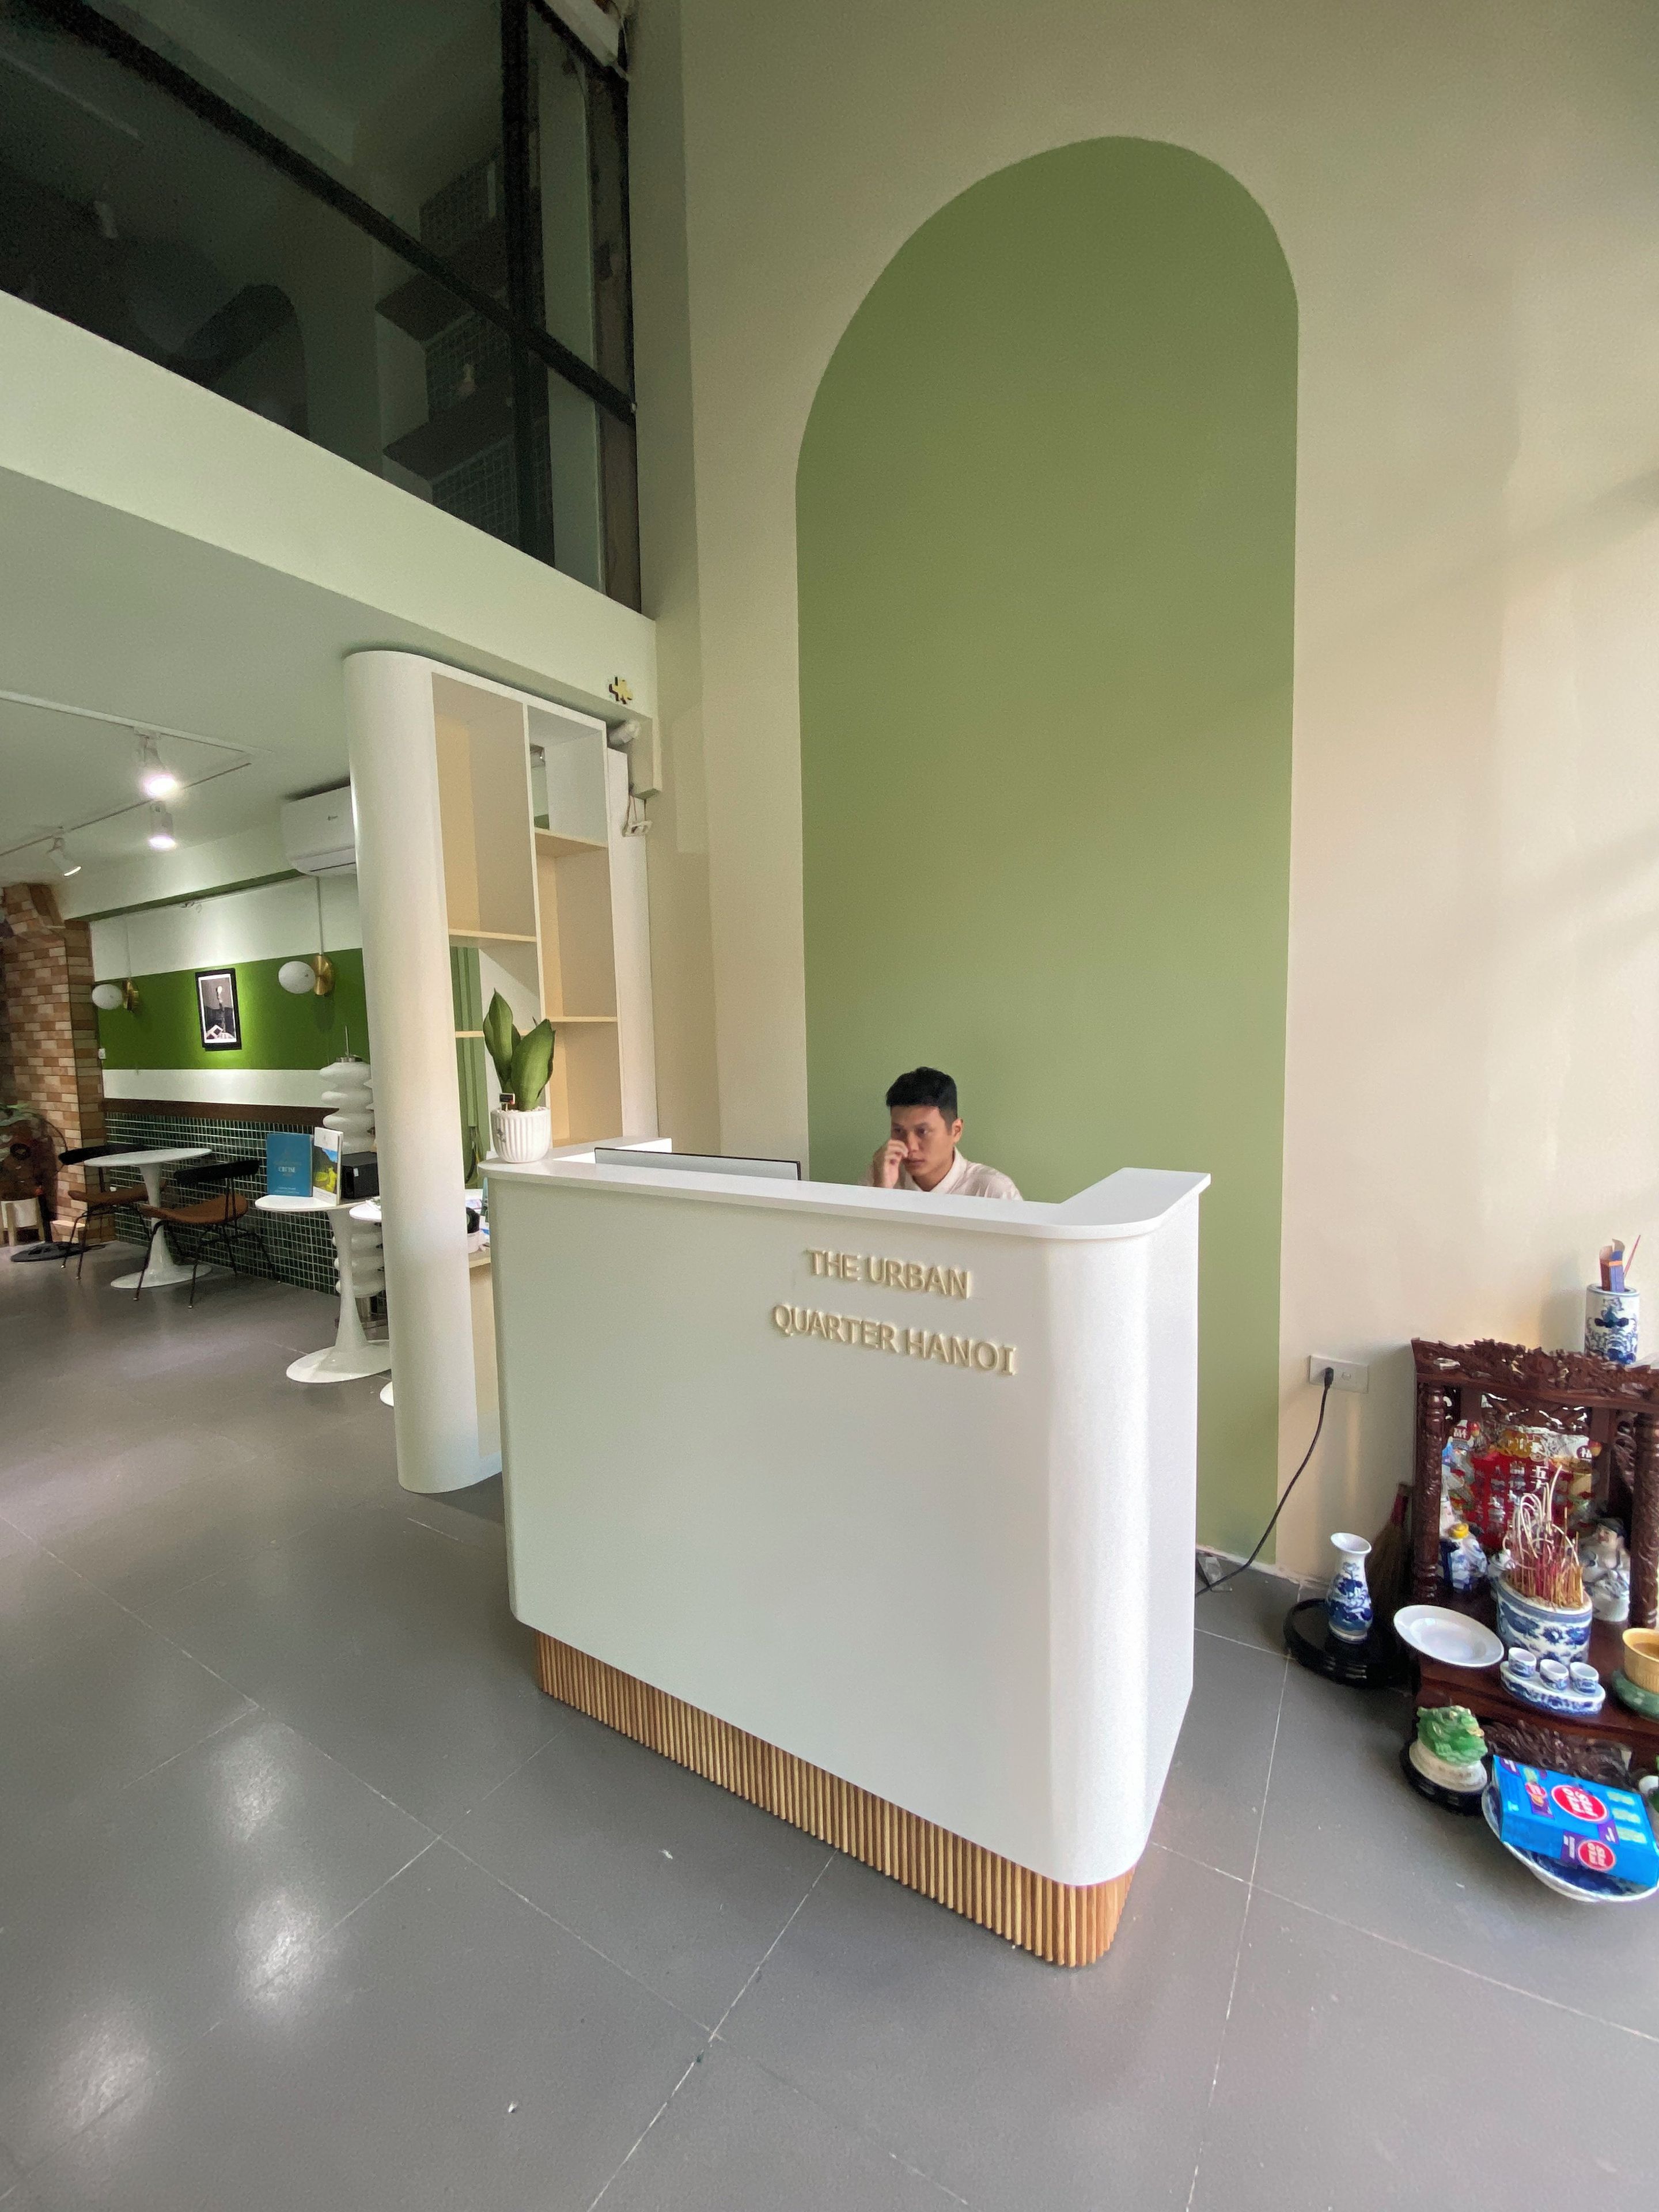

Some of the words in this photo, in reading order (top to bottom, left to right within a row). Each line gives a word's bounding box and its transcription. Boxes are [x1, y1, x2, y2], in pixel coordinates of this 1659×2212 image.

[807, 1248, 861, 1282] THE
[868, 1255, 972, 1299] URBAN
[772, 1304, 899, 1353] QUARTER
[905, 1327, 1018, 1376] HANOI
